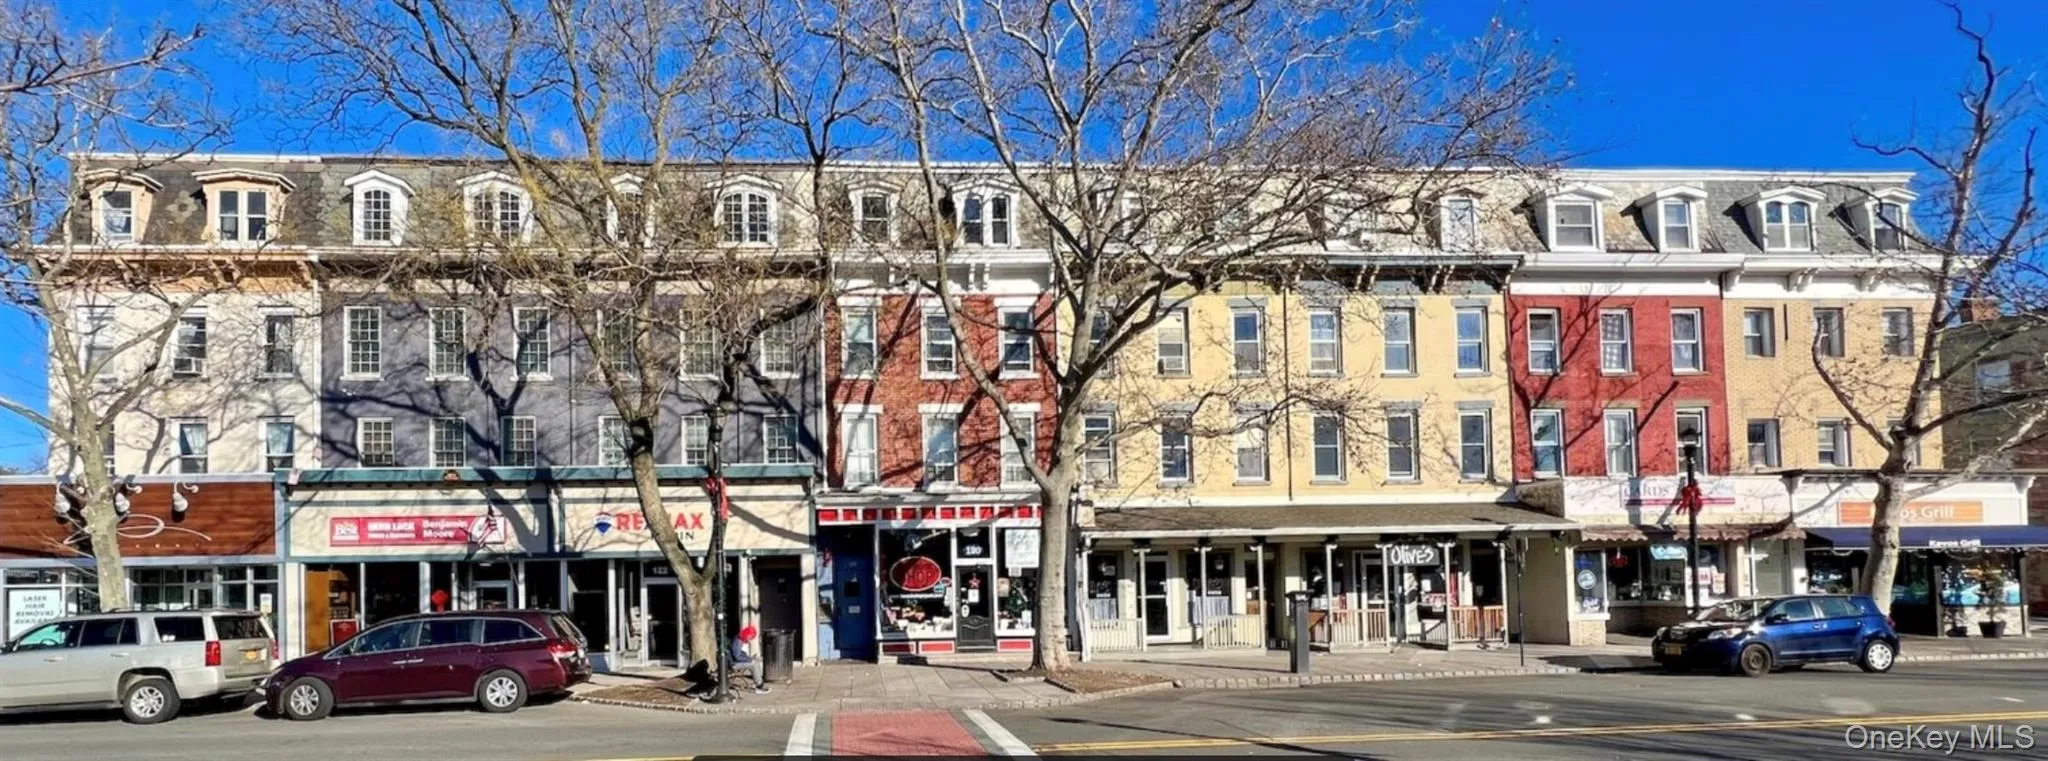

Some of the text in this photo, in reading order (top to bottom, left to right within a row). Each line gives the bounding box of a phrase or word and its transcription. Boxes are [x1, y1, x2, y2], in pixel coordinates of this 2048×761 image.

[1922, 506, 1954, 519] Grill
[422, 520, 468, 530] Benjamin
[423, 529, 454, 538] Moore
[1960, 538, 1981, 548] Grill
